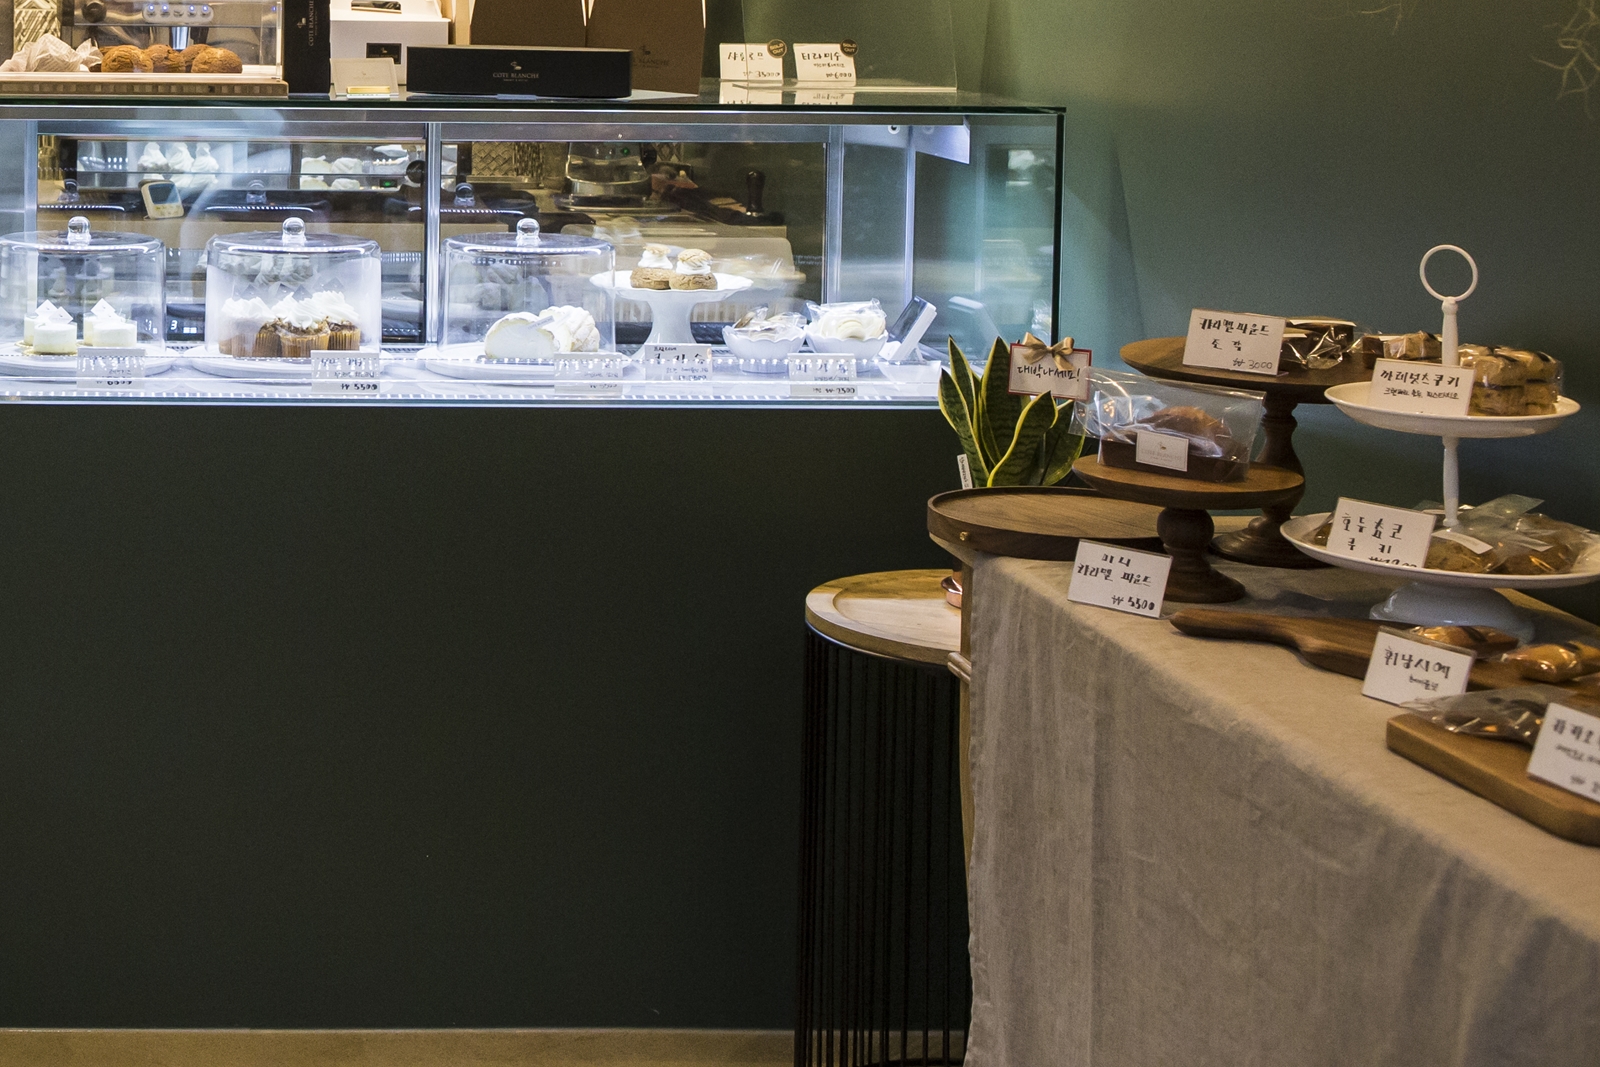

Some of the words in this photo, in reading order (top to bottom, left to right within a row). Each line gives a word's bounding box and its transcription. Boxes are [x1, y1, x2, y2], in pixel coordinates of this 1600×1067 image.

[801, 51, 842, 61] 티라미수
[1120, 571, 1152, 587] 파운드
[1384, 646, 1451, 679] 휘낭시에
